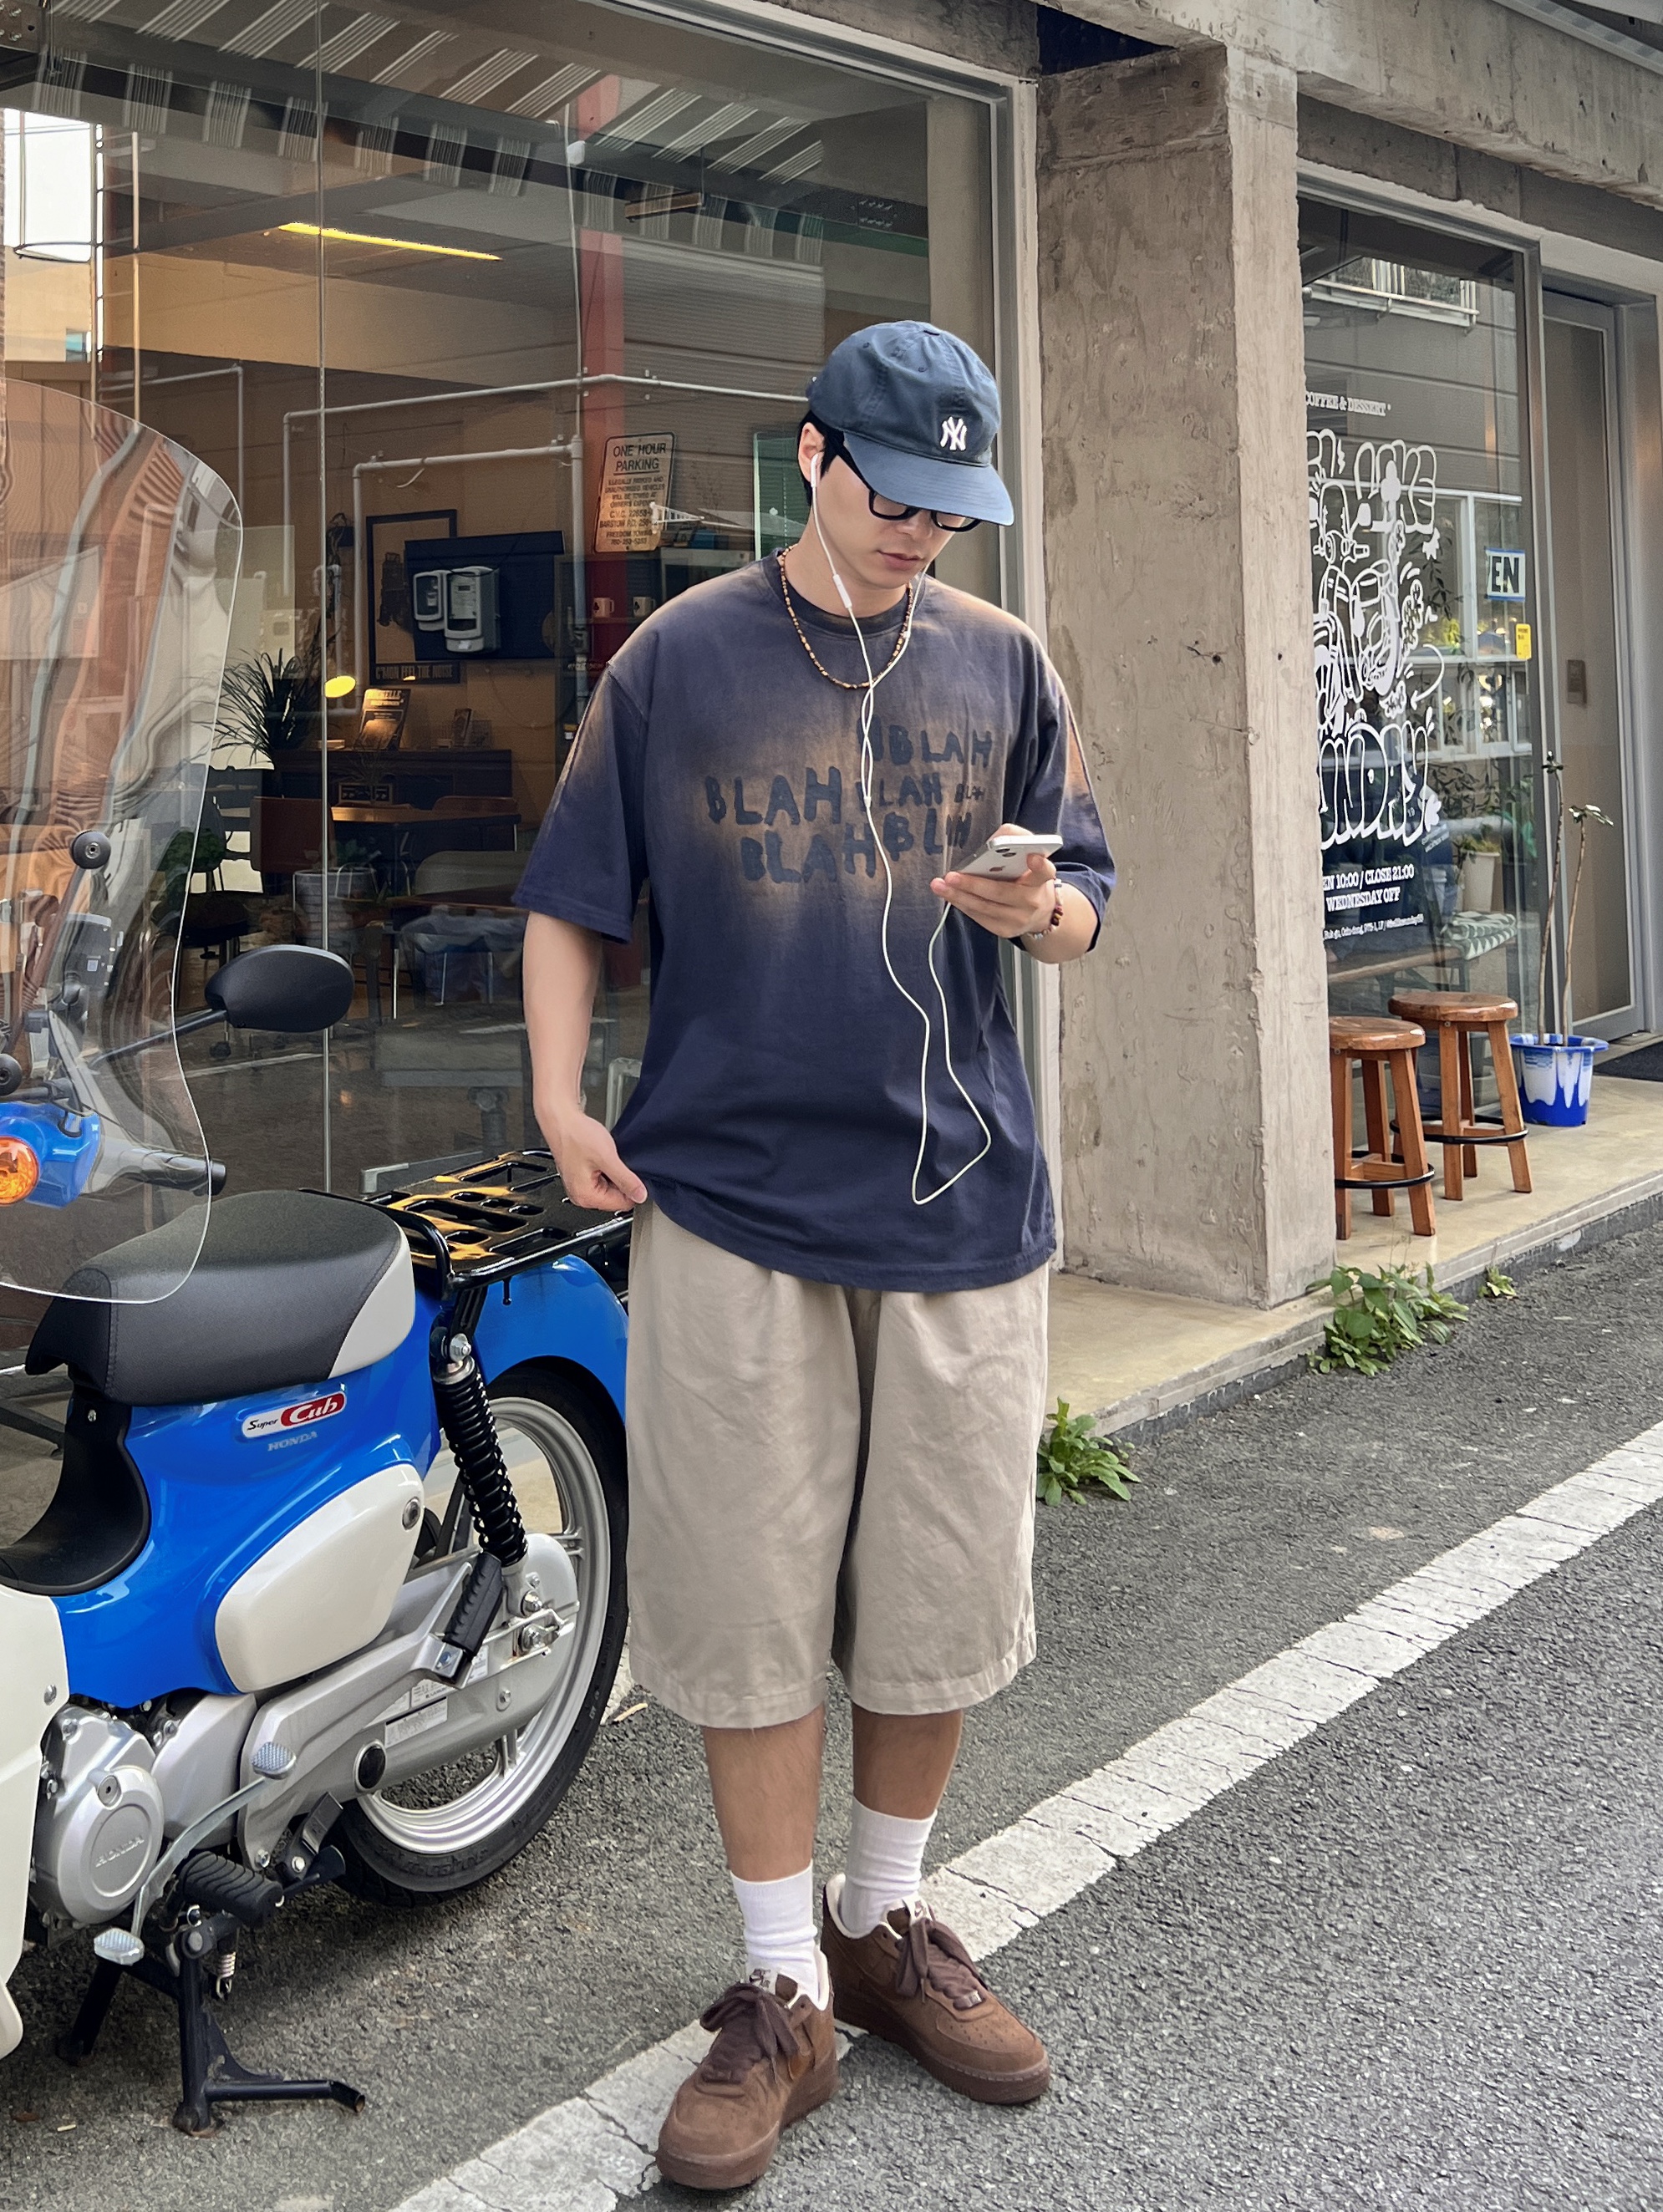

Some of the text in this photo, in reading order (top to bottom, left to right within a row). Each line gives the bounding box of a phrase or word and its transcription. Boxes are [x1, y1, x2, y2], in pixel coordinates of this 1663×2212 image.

[1340, 395, 1347, 411] &
[1347, 397, 1386, 416] DESSERT
[613, 443, 666, 457] ONE HOUR
[616, 458, 659, 471] PARKING
[705, 765, 842, 826] BLAH
[740, 823, 877, 884] BLAH
[1336, 872, 1359, 889] 10:00
[1365, 867, 1391, 885] CLOSE
[1392, 863, 1414, 881] 21:00
[1325, 887, 1401, 912] WEDNESDAY OFF
[247, 1397, 338, 1430] Super Cub
[267, 1431, 318, 1452] HONDA
[95, 1835, 145, 1868] HONDA
